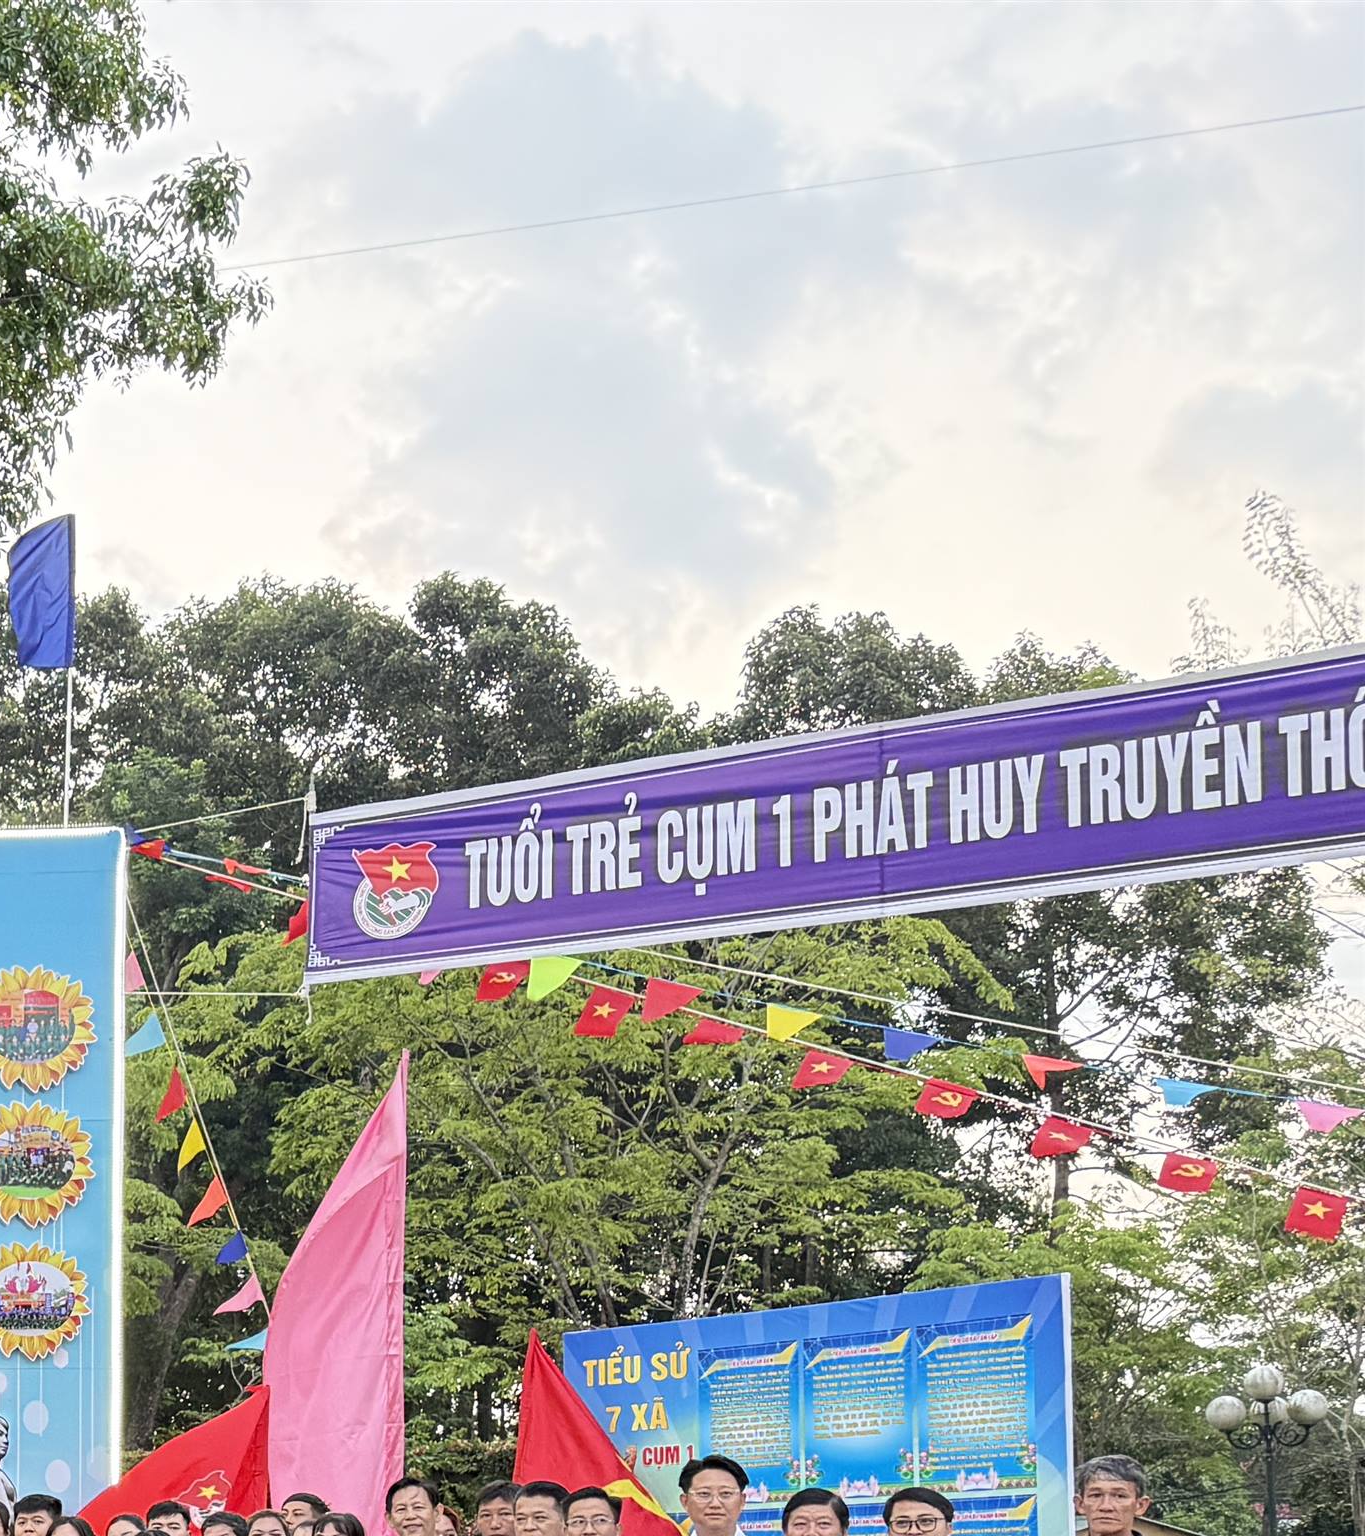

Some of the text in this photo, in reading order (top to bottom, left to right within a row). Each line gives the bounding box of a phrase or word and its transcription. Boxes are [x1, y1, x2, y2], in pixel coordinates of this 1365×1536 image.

[466, 803, 552, 908] TUỔI
[564, 792, 643, 897] TRẺ
[657, 799, 756, 897] CỤM
[772, 794, 792, 869] 1
[814, 760, 933, 863] PHÁT
[950, 752, 1043, 842] HUY
[1059, 700, 1263, 827] TRUYỀN
[582, 1341, 691, 1387] TIỂU SỬ
[606, 1397, 668, 1432] 7 XÃ
[642, 1445, 693, 1470] CỤM 1
